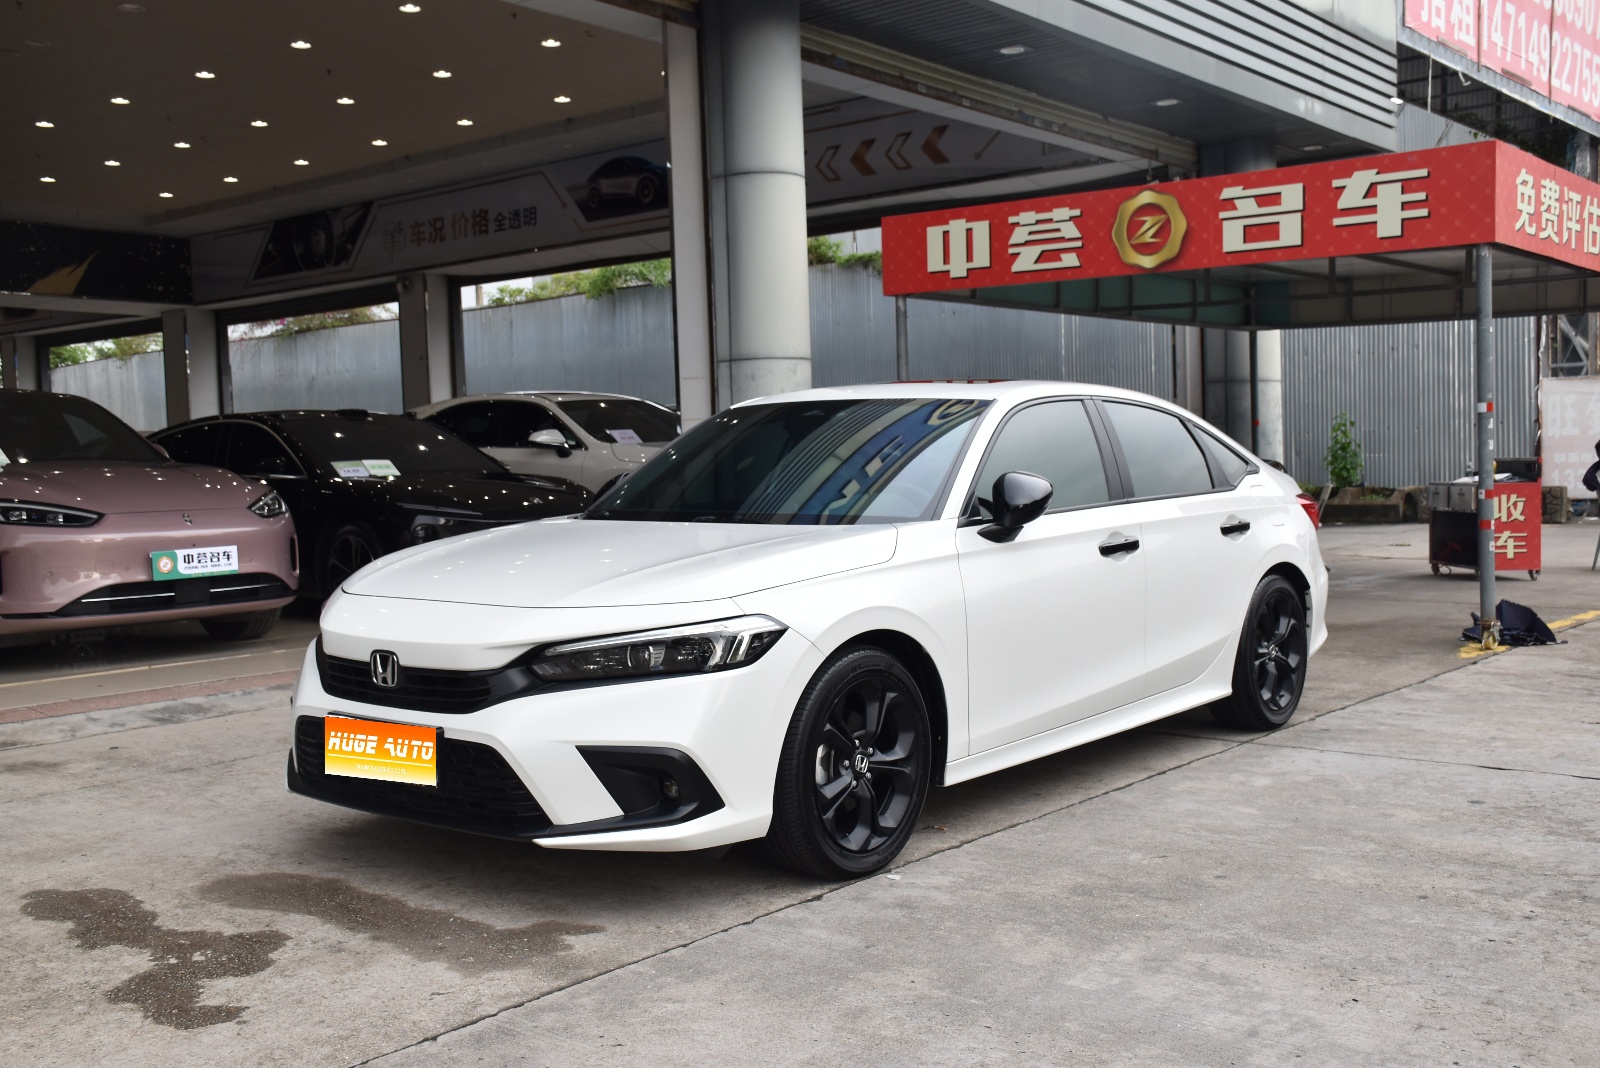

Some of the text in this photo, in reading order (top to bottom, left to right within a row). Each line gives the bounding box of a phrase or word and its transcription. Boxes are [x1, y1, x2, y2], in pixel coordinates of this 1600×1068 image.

[409, 206, 537, 248] 车况 价格 全透明
[926, 207, 1083, 279] 中荟
[1218, 168, 1430, 254] 名车
[1514, 168, 1600, 255] 免费评估
[183, 550, 233, 565] 中荟名车
